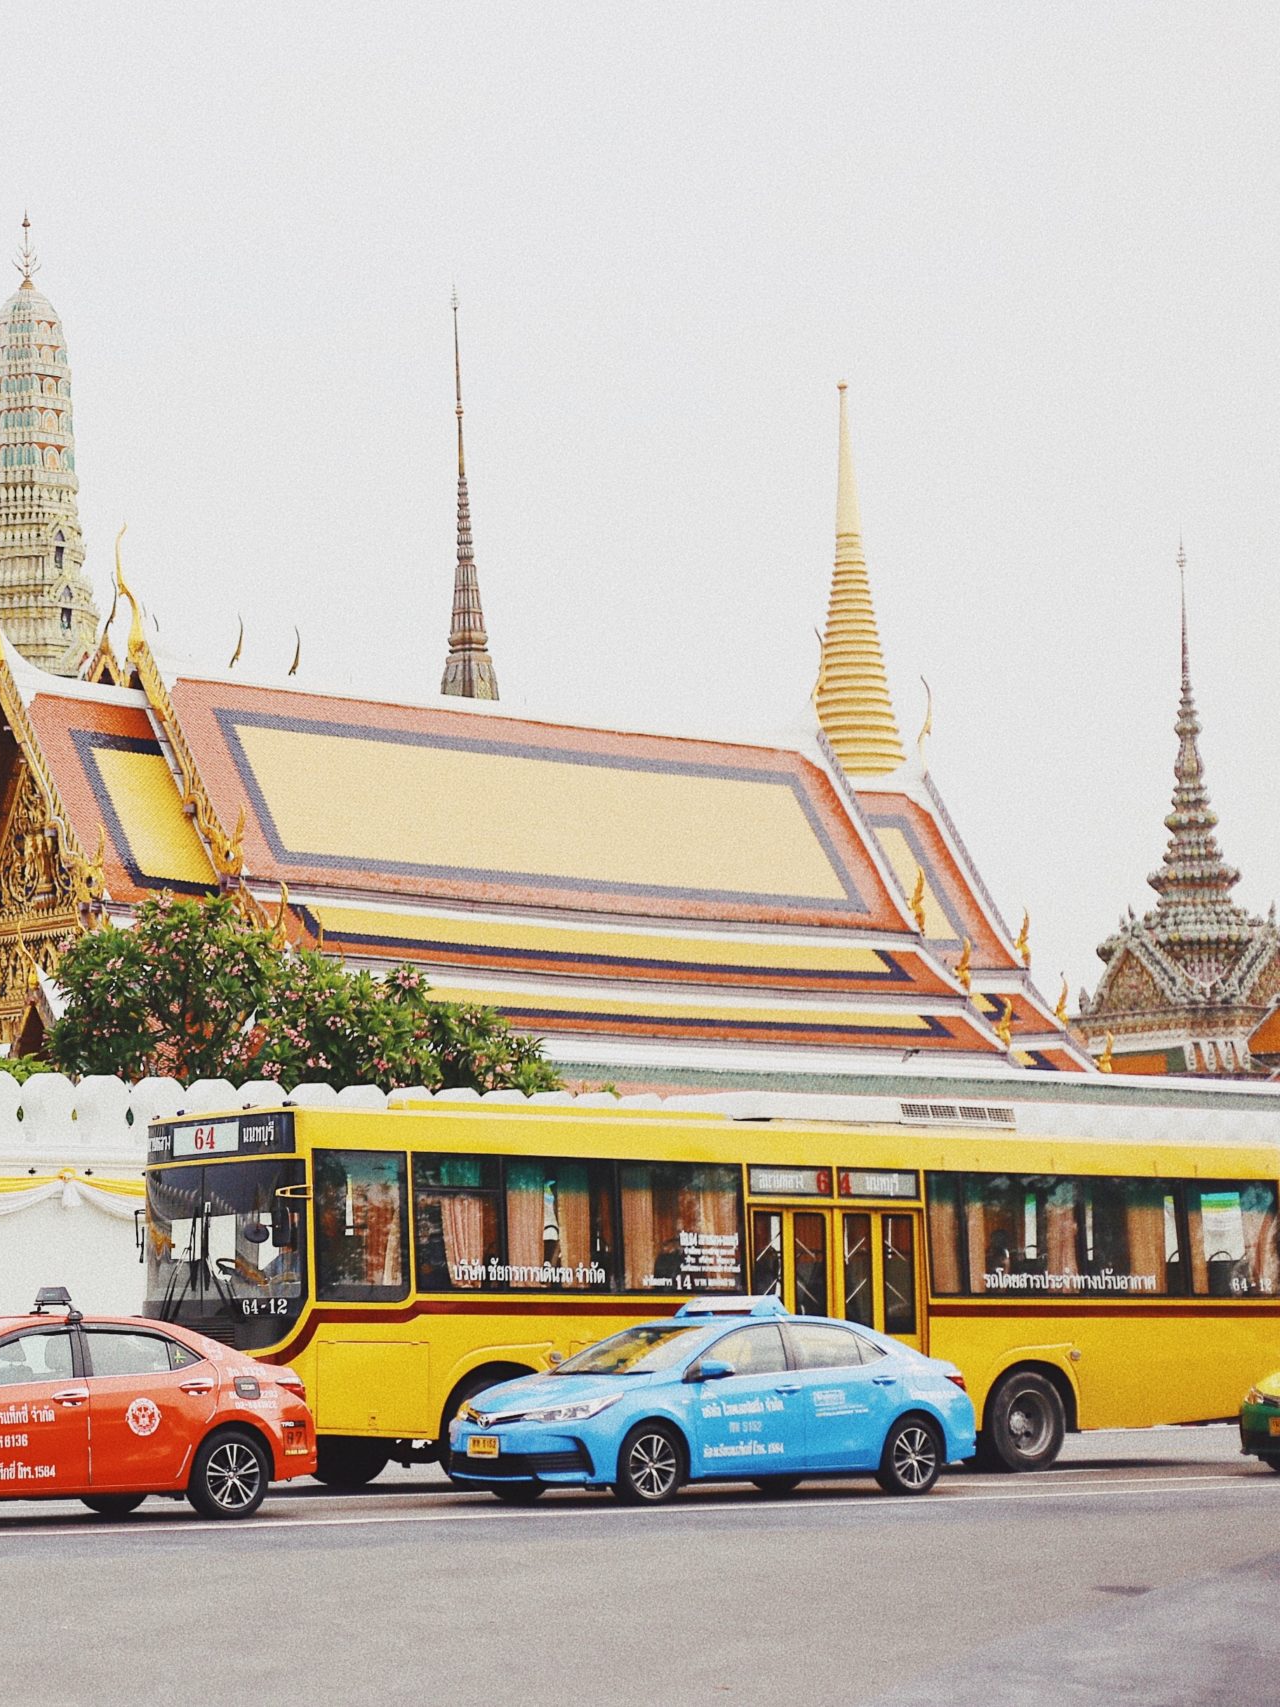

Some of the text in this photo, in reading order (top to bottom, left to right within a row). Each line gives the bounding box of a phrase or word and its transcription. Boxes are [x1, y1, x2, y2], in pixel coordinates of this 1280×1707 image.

[193, 1126, 216, 1151] 64
[453, 1259, 486, 1282] บริษัท
[575, 1261, 606, 1284] จำกัด
[675, 1273, 692, 1290] 14
[31, 1405, 56, 1423] จำกัด
[4, 1433, 29, 1448] 6136
